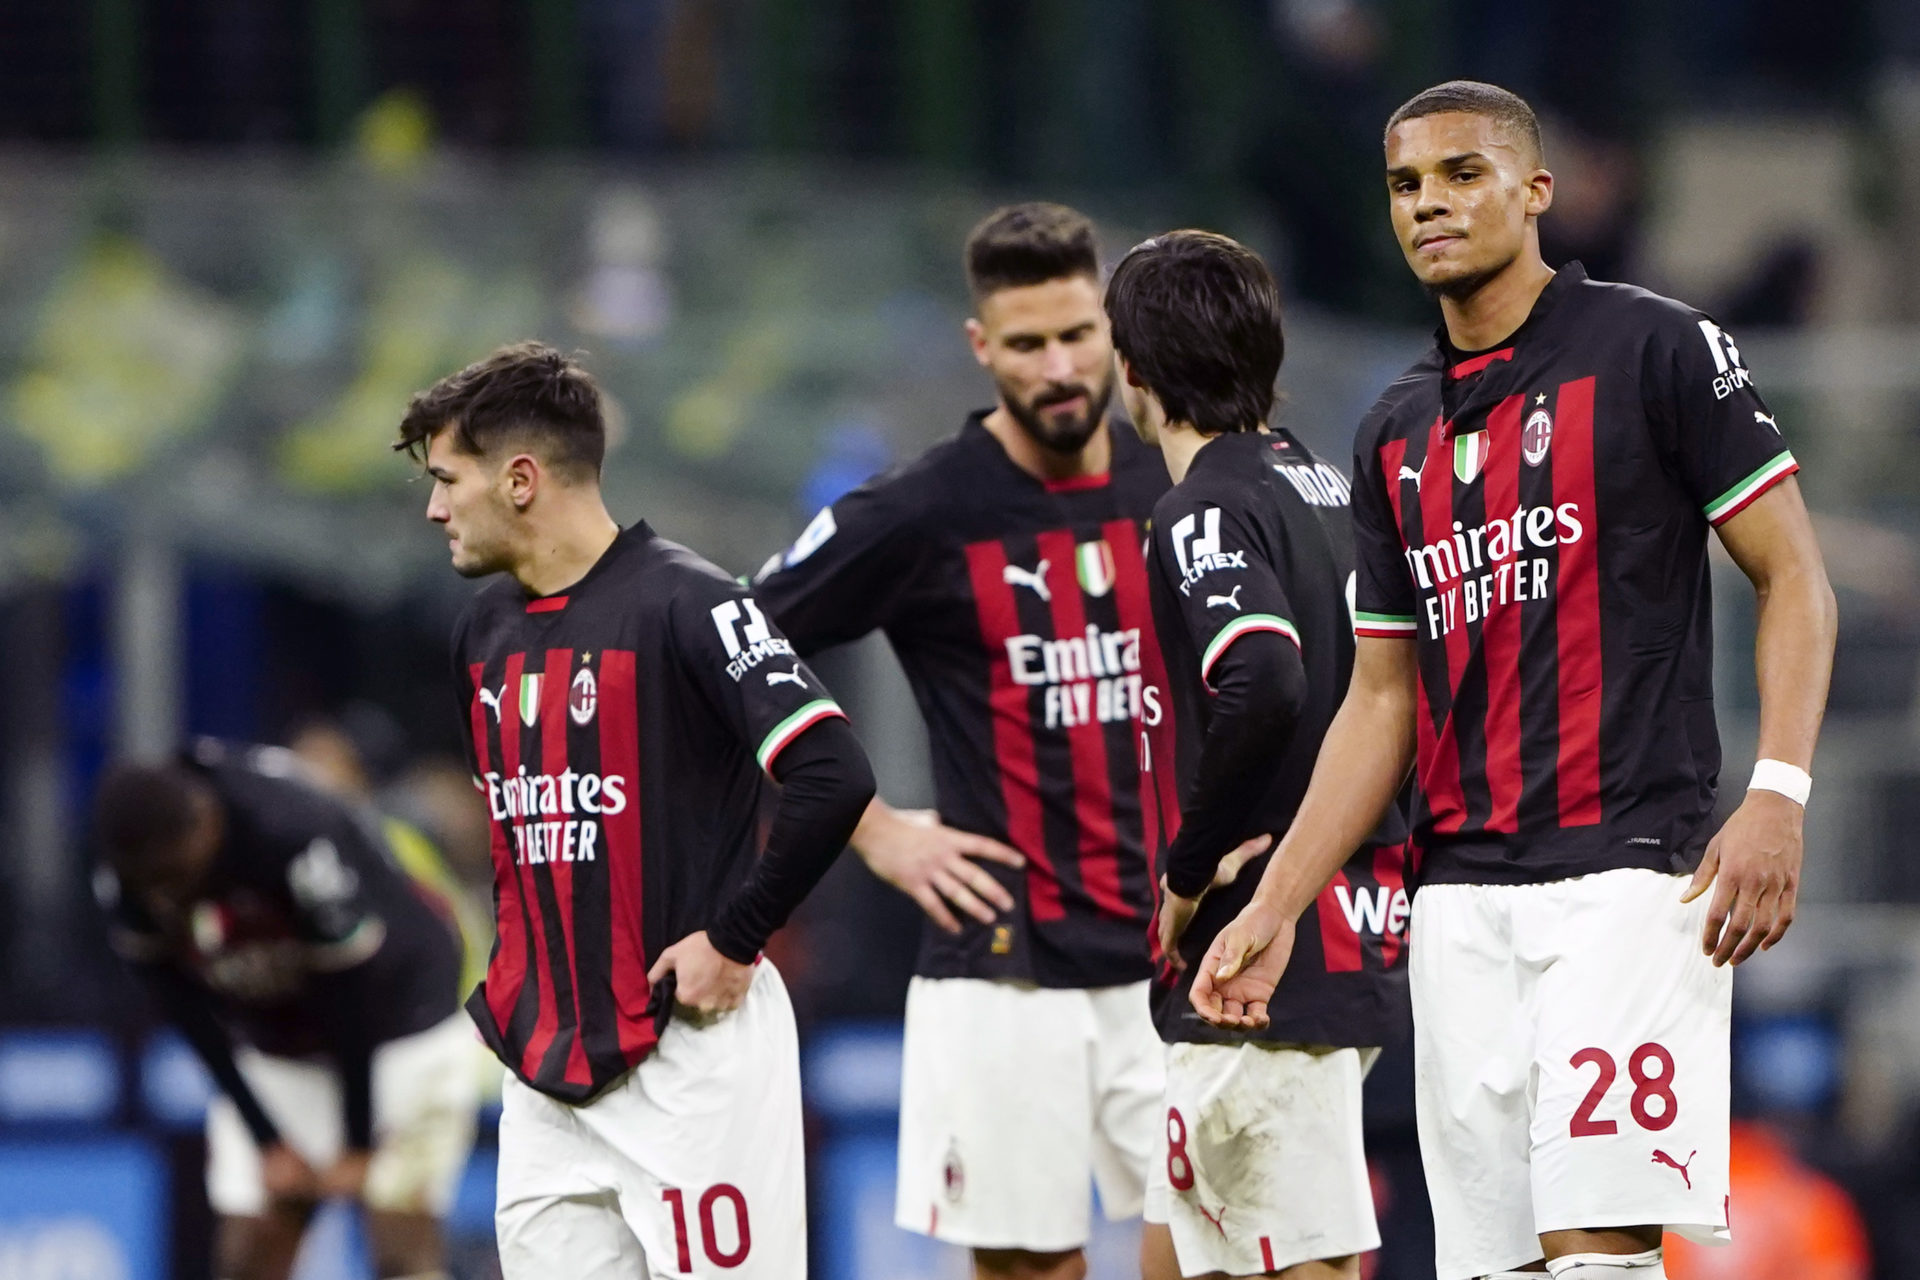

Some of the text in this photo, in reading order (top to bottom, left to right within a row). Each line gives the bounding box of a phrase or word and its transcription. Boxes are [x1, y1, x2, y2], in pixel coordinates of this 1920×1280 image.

[1405, 503, 1583, 589] mirates
[1426, 588, 1457, 640] FLY
[1464, 558, 1549, 623] BETER
[1004, 623, 1140, 685] Emira
[1045, 683, 1090, 729] FLY
[1097, 674, 1142, 722] BET
[484, 764, 627, 821] Emirates
[1569, 1042, 1678, 1138] 28
[1167, 1106, 1195, 1191] 8
[661, 1183, 752, 1274] 10
